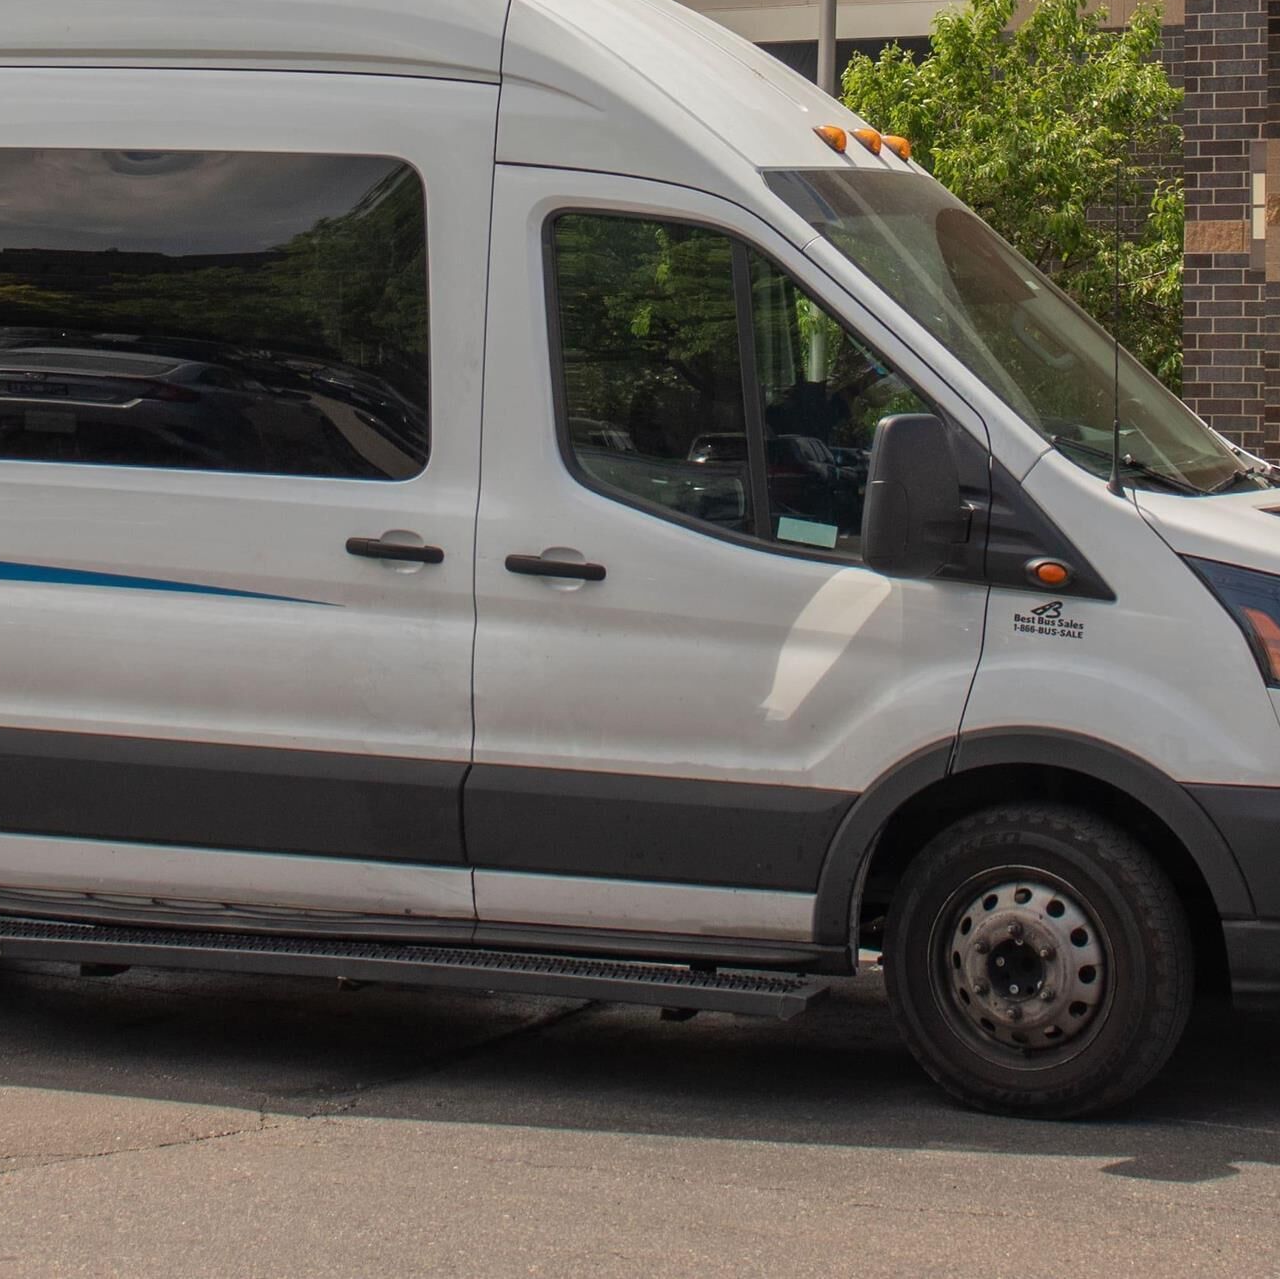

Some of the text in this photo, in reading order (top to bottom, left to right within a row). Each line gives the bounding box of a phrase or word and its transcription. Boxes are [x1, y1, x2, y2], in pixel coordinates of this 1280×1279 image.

[1014, 613, 1084, 630] Best Bus Sales
